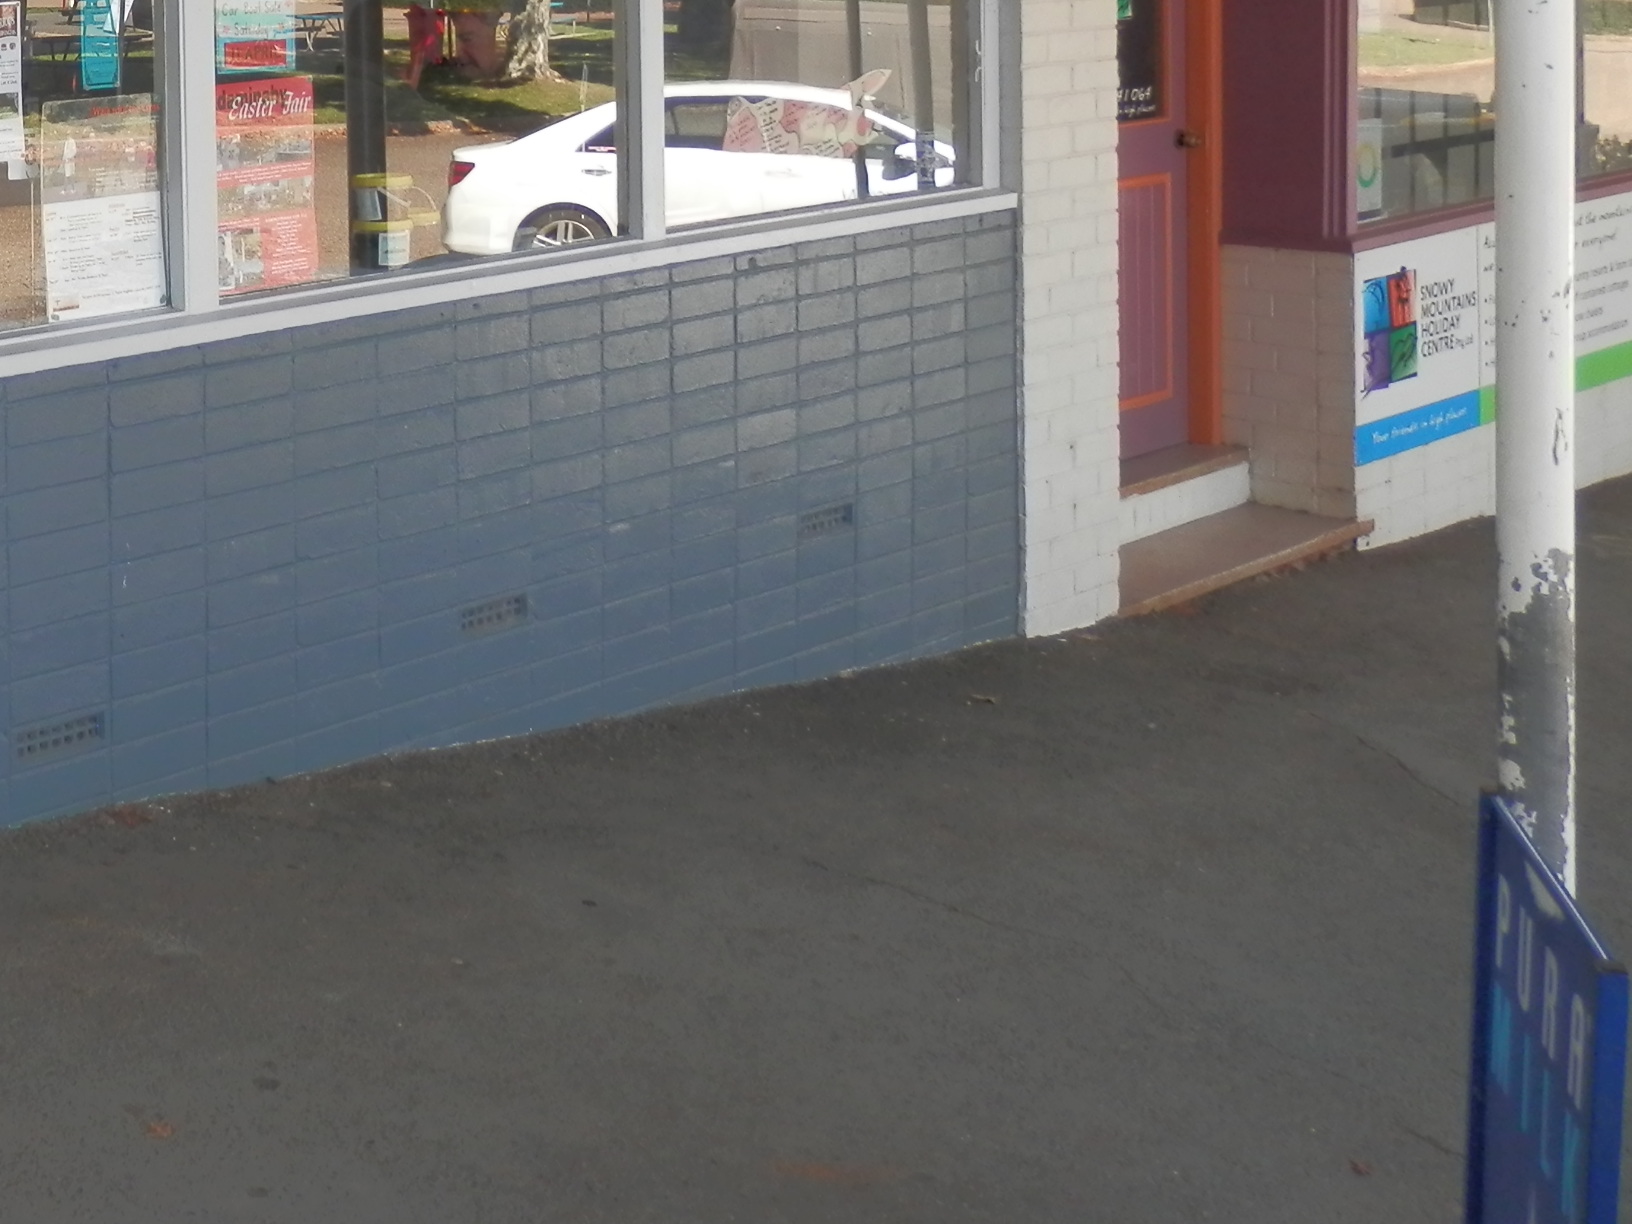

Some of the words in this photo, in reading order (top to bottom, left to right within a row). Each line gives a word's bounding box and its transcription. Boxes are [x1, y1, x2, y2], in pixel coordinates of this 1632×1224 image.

[228, 95, 276, 121] Easter
[282, 90, 312, 116] Fair
[1420, 278, 1455, 301] SNOWY
[1421, 291, 1477, 318] MOUNTAINS
[1421, 313, 1462, 339] HOLIDAY
[1421, 334, 1455, 357] CENTRE
[1496, 873, 1588, 1112] PURA
